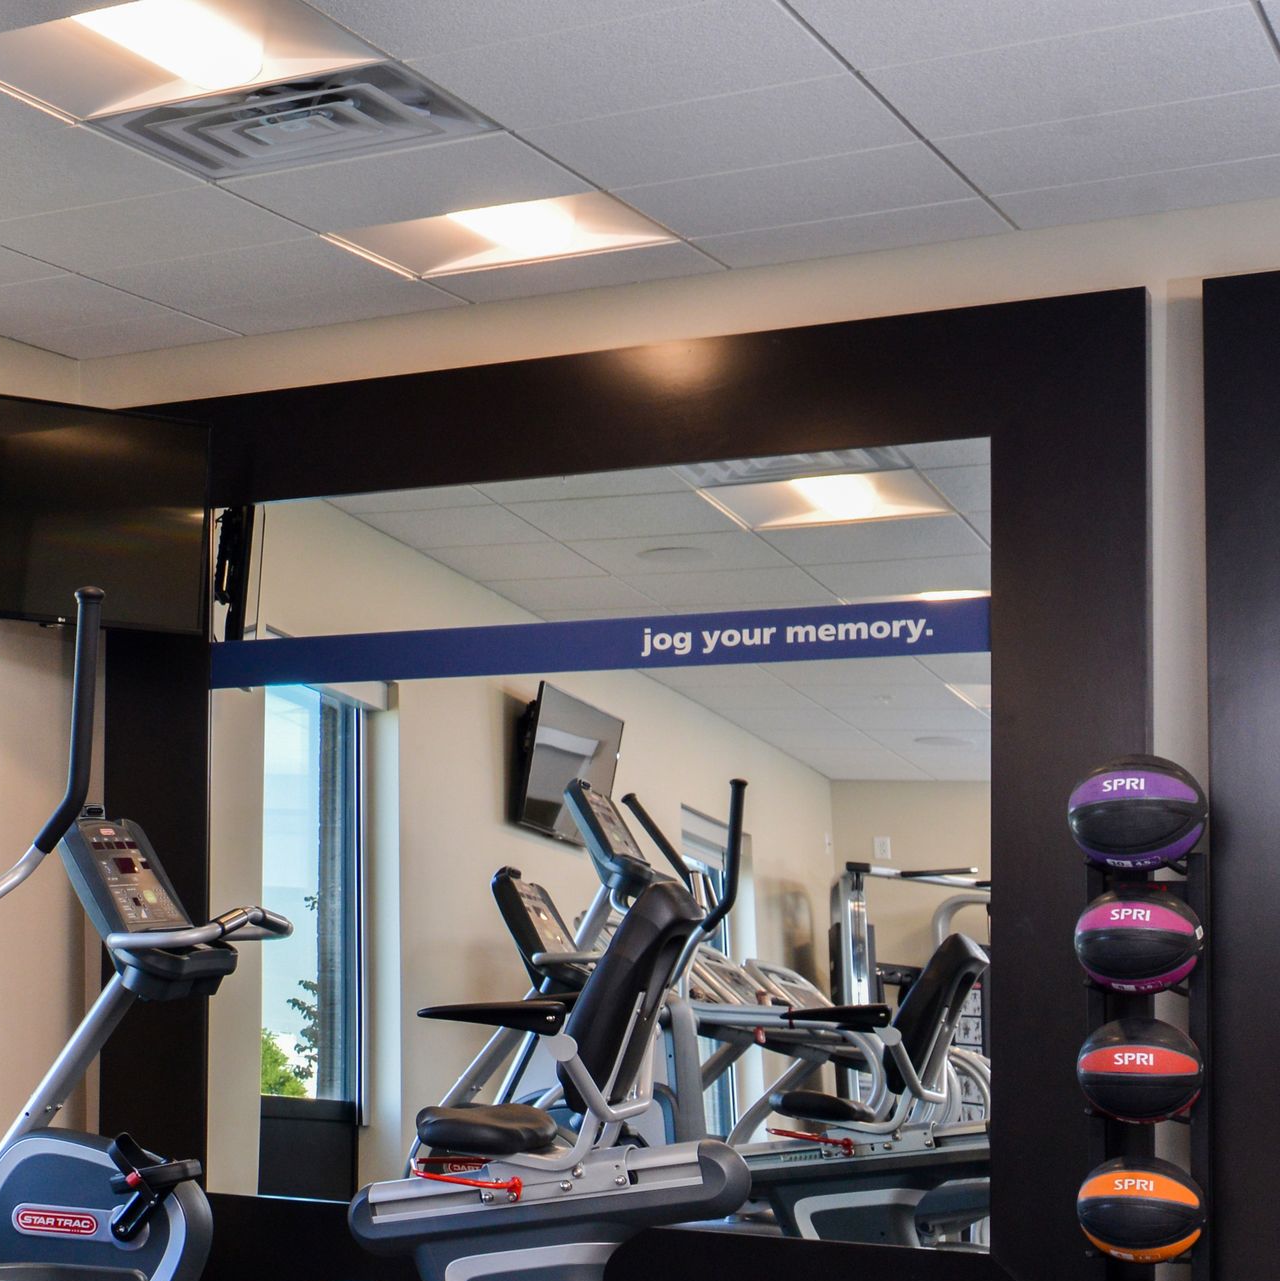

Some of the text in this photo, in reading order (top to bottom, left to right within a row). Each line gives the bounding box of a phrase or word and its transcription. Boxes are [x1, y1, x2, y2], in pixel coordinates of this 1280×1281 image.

[641, 619, 933, 656] jog your memory.
[1102, 778, 1144, 792] SPRI
[1110, 908, 1151, 921] SPRI
[1113, 1053, 1154, 1066] SPRI
[1113, 1179, 1154, 1191] SPRI
[22, 1215, 91, 1229] STAR TRAC
